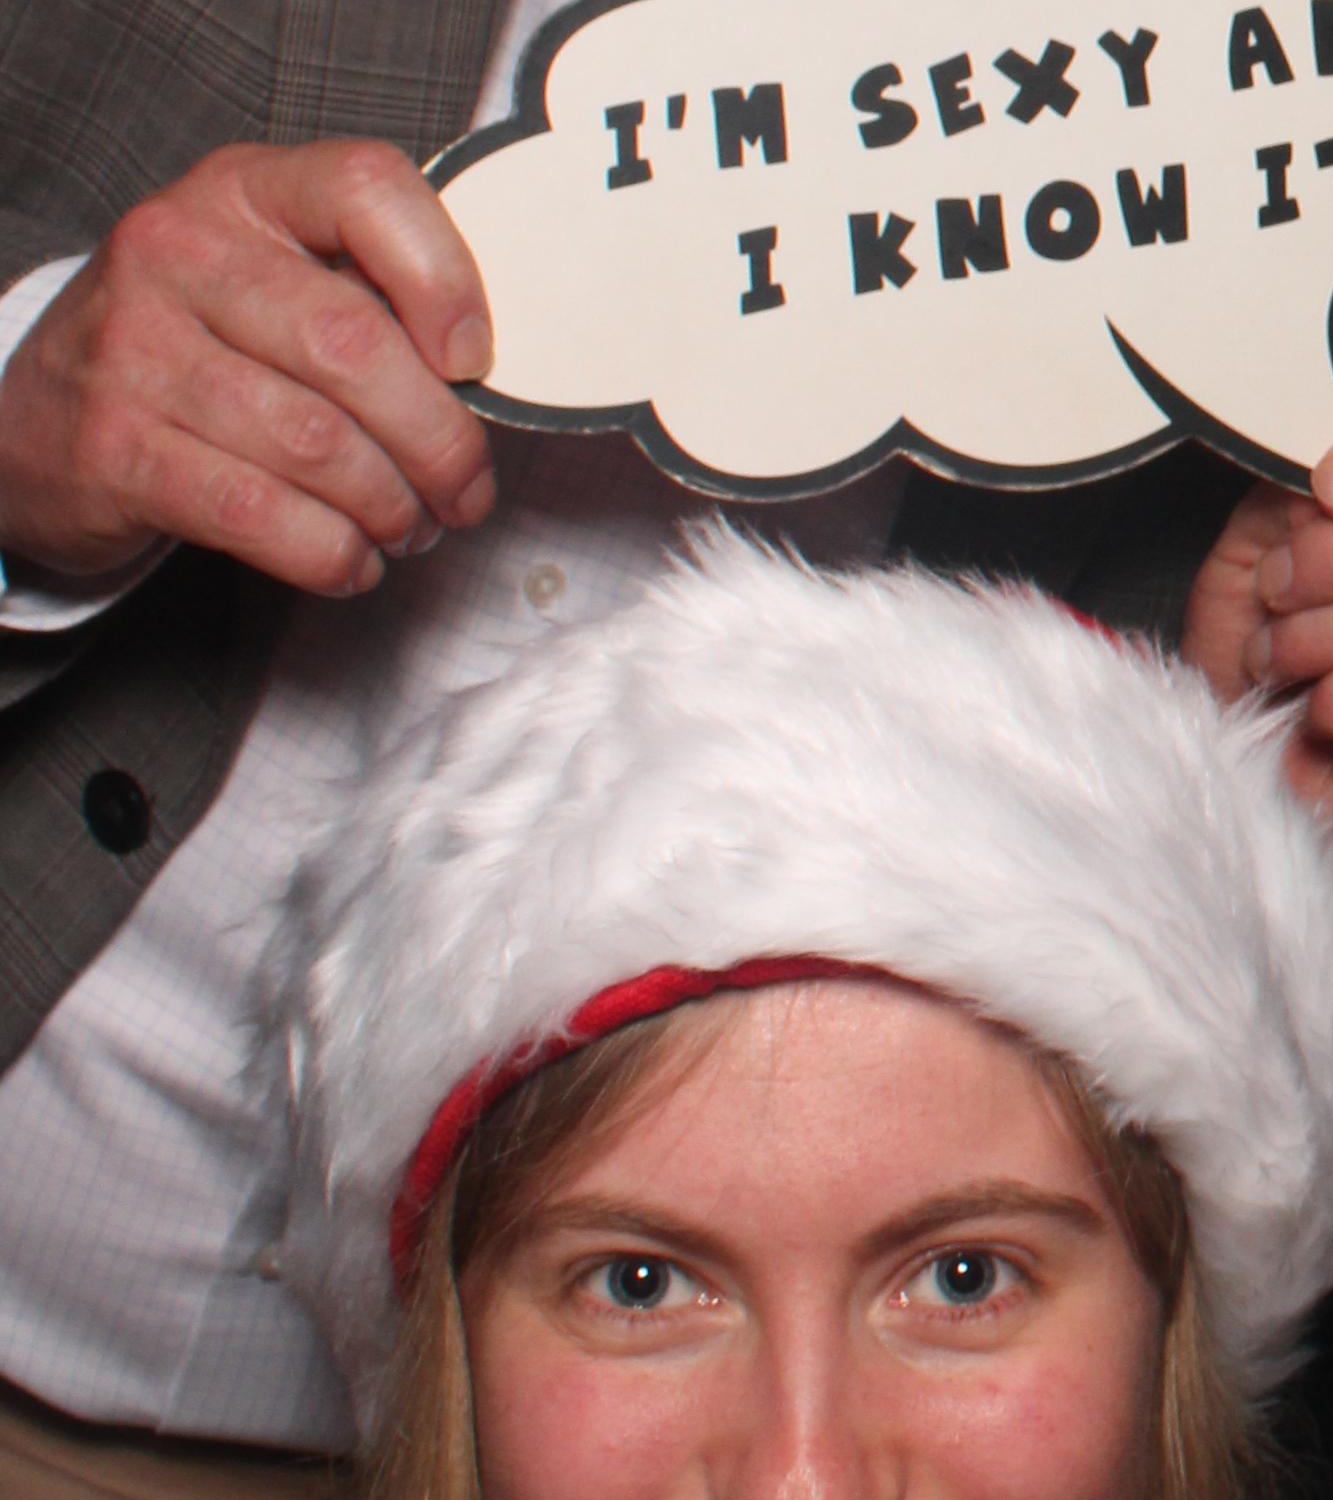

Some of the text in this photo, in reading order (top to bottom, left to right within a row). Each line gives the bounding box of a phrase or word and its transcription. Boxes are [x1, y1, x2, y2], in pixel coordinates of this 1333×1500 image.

[604, 82, 789, 191] I'M
[850, 27, 1159, 150] SEXY
[737, 225, 786, 316] I
[847, 162, 1190, 296] KNOW
